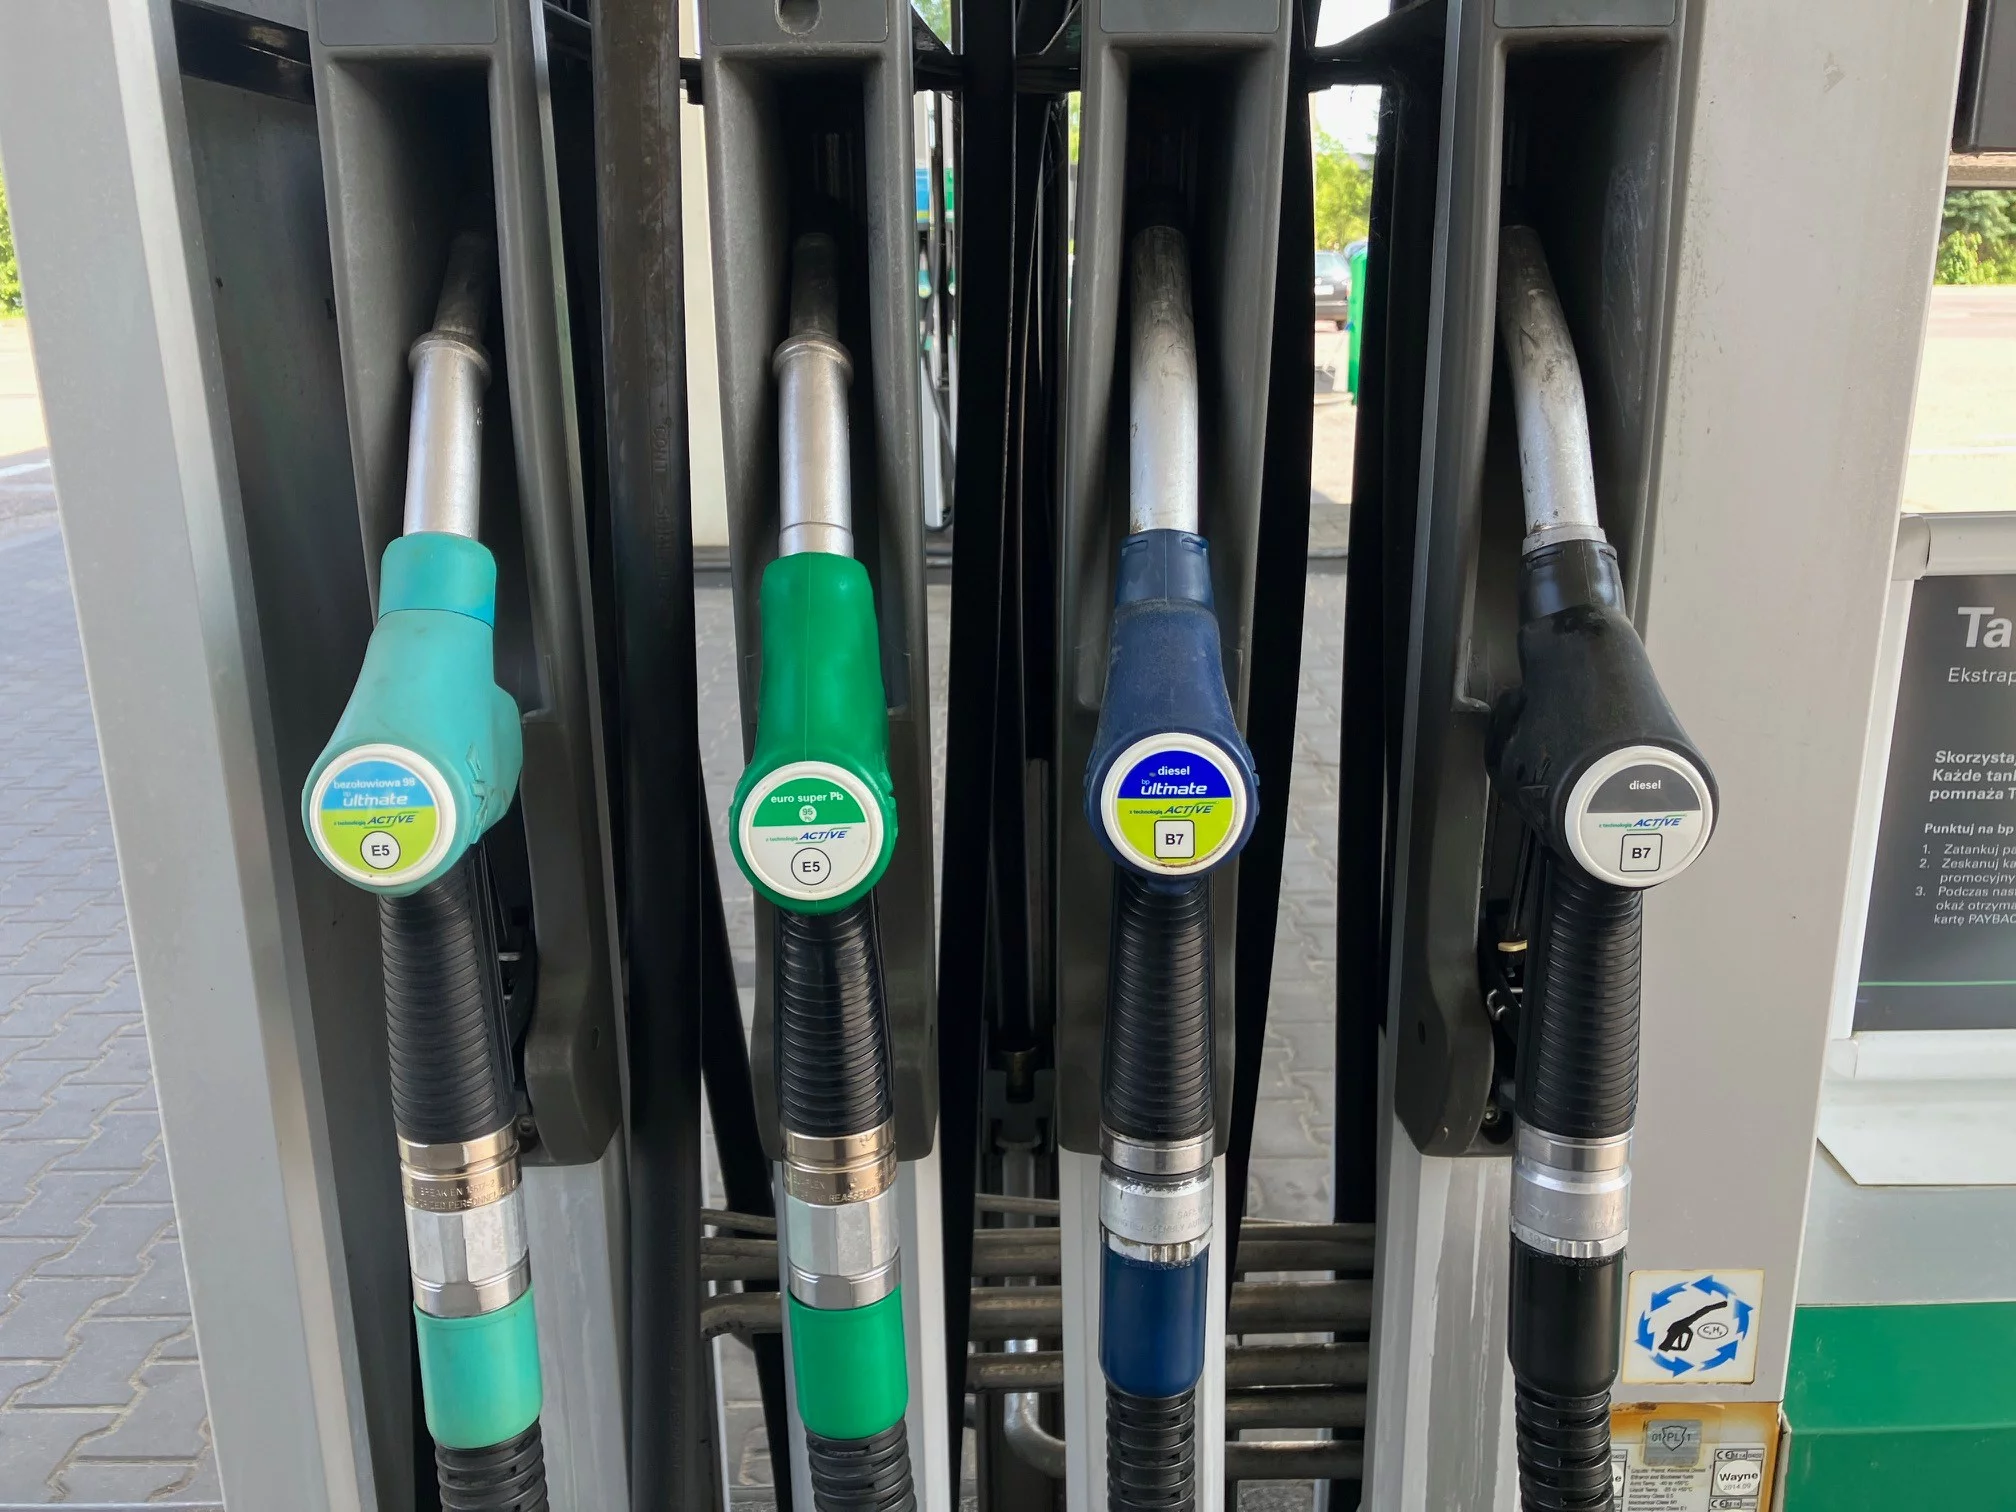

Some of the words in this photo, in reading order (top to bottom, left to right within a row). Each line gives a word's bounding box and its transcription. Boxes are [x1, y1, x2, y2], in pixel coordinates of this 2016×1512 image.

[1957, 606, 2013, 648] Ta
[1157, 766, 1190, 775] diesel
[1932, 768, 1982, 782] Każde
[1140, 782, 1208, 795] ultimate
[1629, 780, 1662, 790] diesel
[343, 793, 408, 807] ultimate
[770, 795, 794, 803] euro
[797, 794, 827, 804] super
[829, 791, 844, 801] Pb
[1929, 787, 2004, 802] pomnaża
[802, 808, 813, 816] 95
[1164, 804, 1213, 814] ACTIVE
[367, 814, 416, 824] ACTIVE
[1633, 817, 1682, 827] ACTIVE
[799, 830, 848, 840] ACTIVE
[1924, 823, 1975, 836] Punktuj
[1978, 825, 1994, 834] na
[1997, 823, 2014, 836] bp
[1165, 834, 1184, 845] B7
[371, 845, 390, 857] E5
[1632, 848, 1651, 859] B7
[1922, 844, 1931, 855] 1.
[1944, 843, 1999, 857] Zatankuj
[802, 861, 821, 872] E5
[1919, 858, 1930, 869] 2.
[1941, 857, 1999, 871] Zeskanuj
[1940, 872, 2016, 885] promocyjny
[1915, 886, 1926, 896] 3.
[1938, 886, 1989, 897] Podczas
[1667, 1433, 1681, 1442] PL
[1719, 1473, 1758, 1482] Wayne
